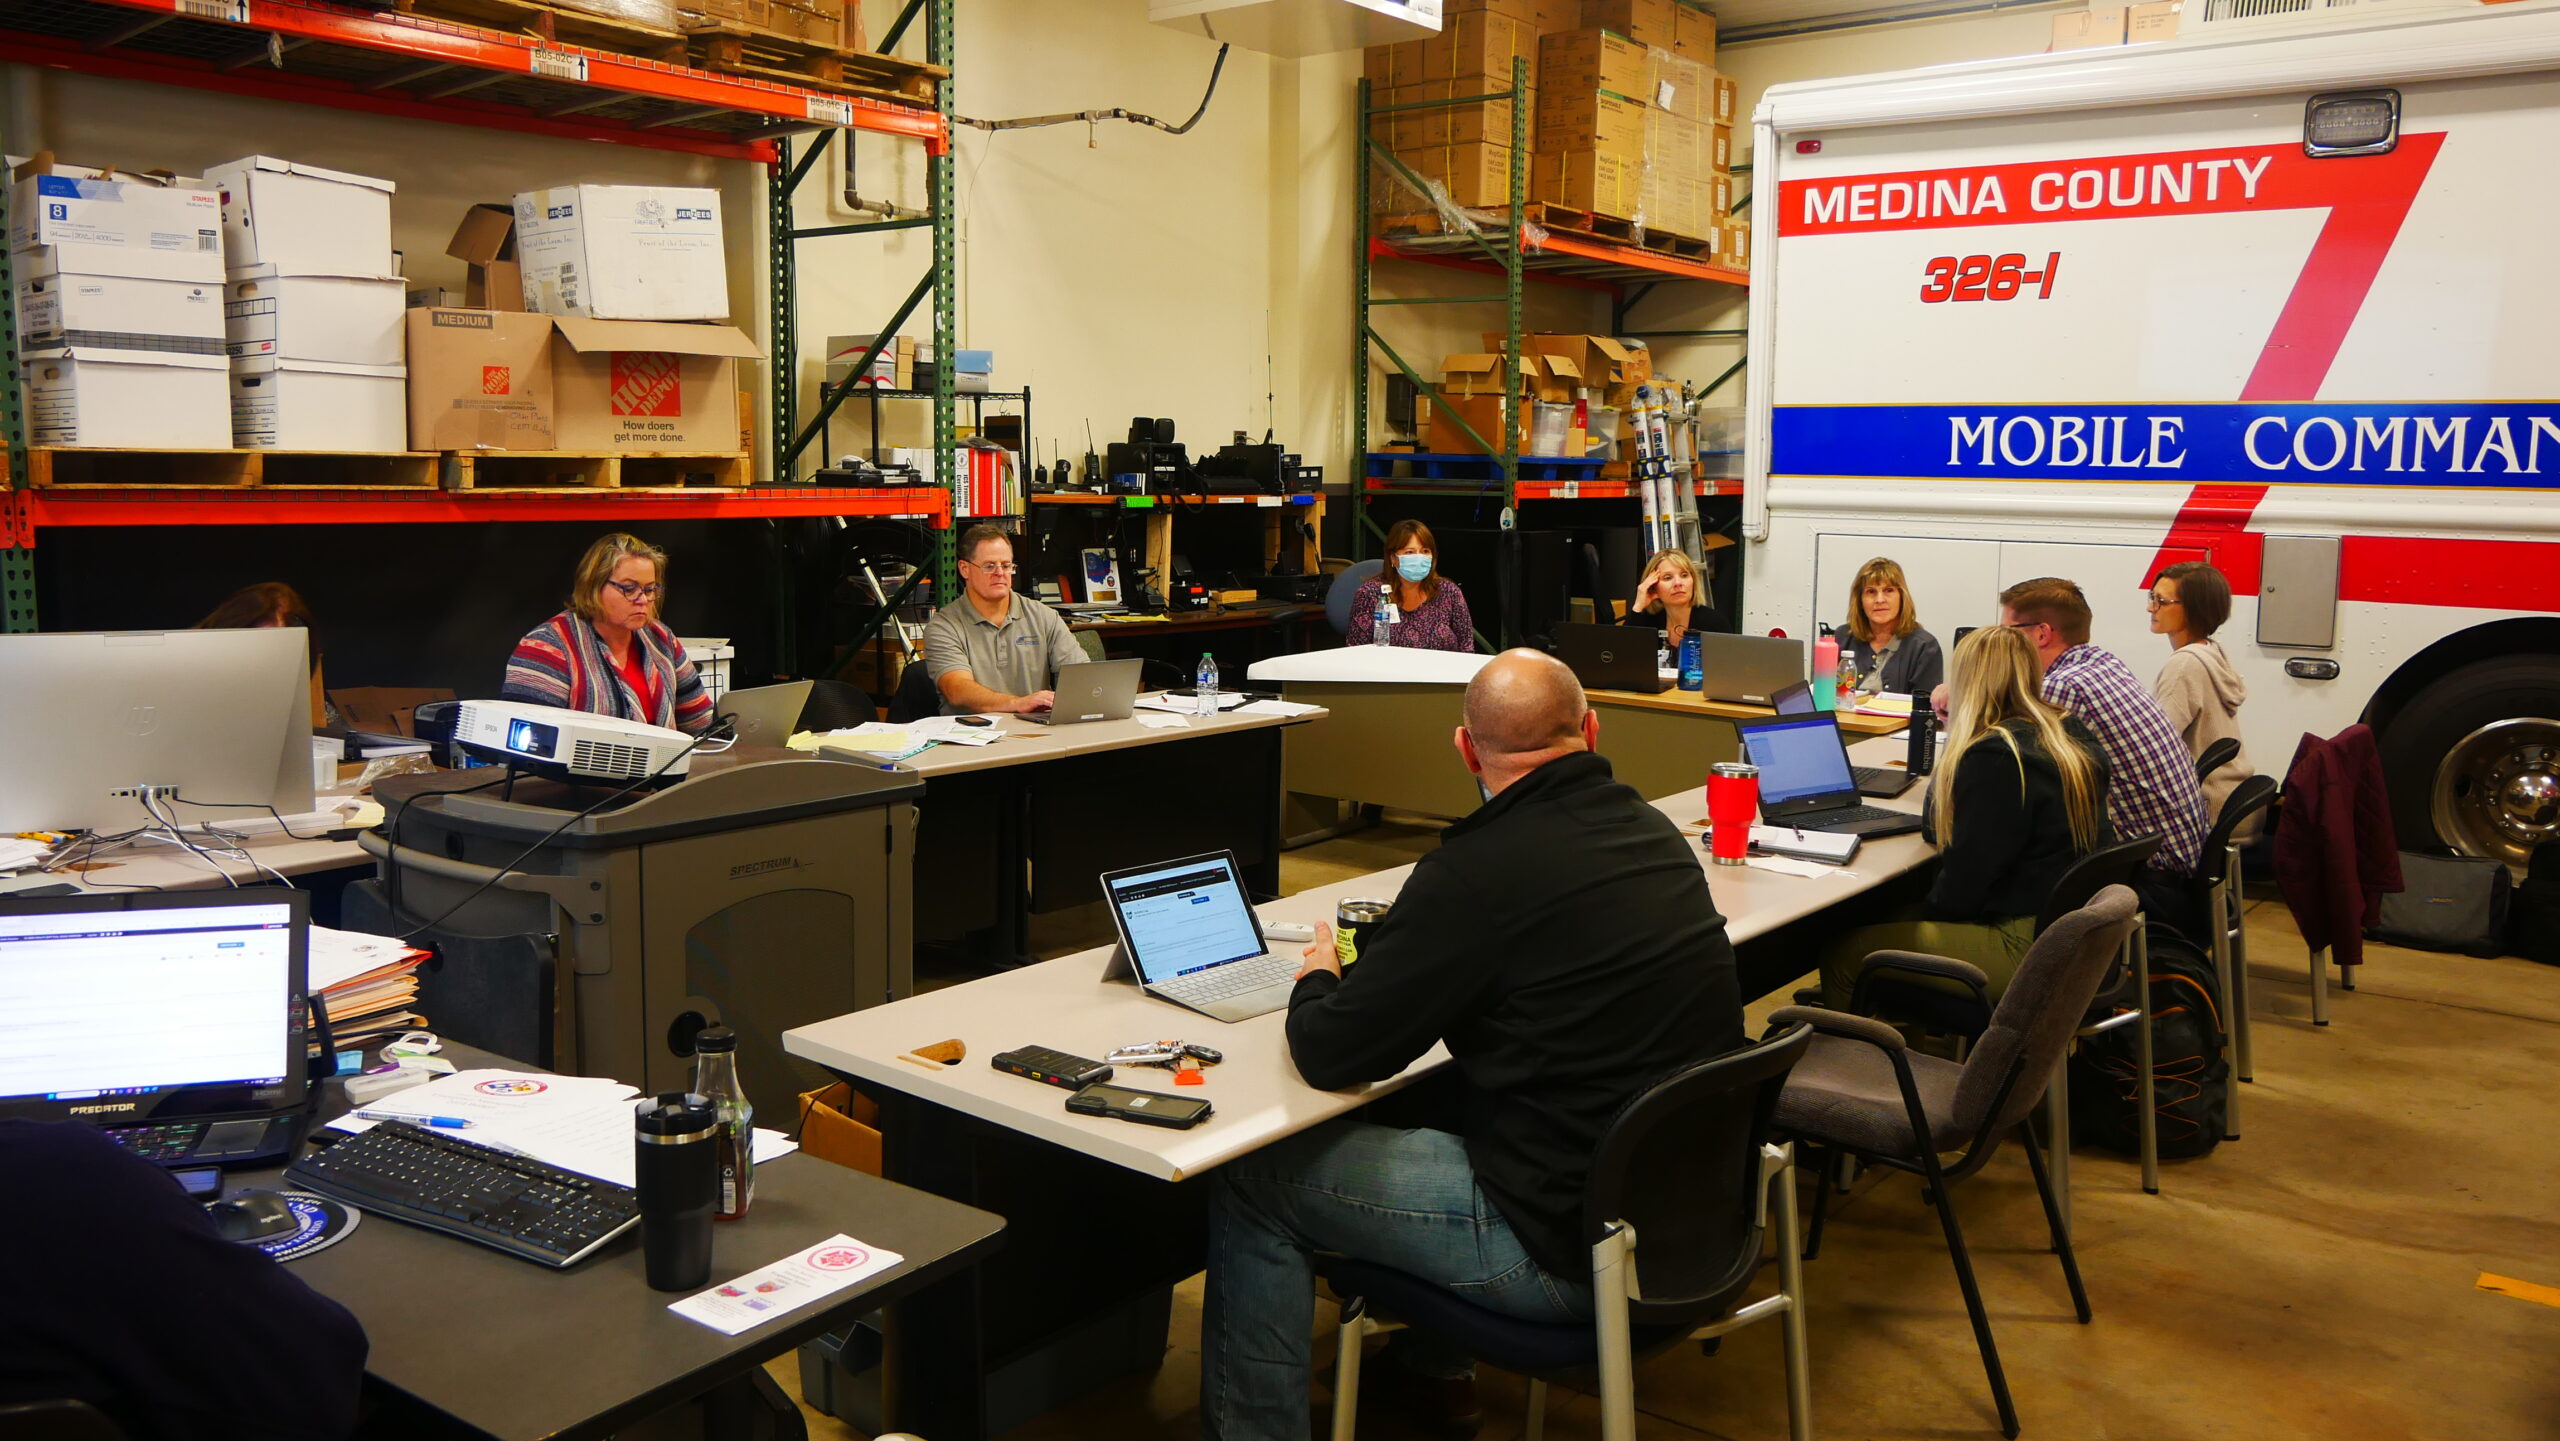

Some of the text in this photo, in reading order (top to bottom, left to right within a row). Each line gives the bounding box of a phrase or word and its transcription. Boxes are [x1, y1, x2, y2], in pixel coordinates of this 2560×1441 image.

[535, 49, 573, 64] B05-02C
[1804, 156, 2273, 225] MEDINA COUNTY
[52, 204, 63, 217] 8
[677, 209, 712, 219] JERZEES
[437, 314, 489, 327] MEDIUM
[484, 367, 510, 394] HOME
[639, 369, 681, 416] DEPOT
[623, 420, 675, 431] How doers
[614, 432, 686, 443] get more done.
[1947, 416, 2187, 468] MOBILE
[484, 723, 498, 735] EPSON
[922, 728, 934, 770] Columbia
[729, 856, 792, 877] SPECTRUM
[69, 1102, 136, 1116] PREDATOR
